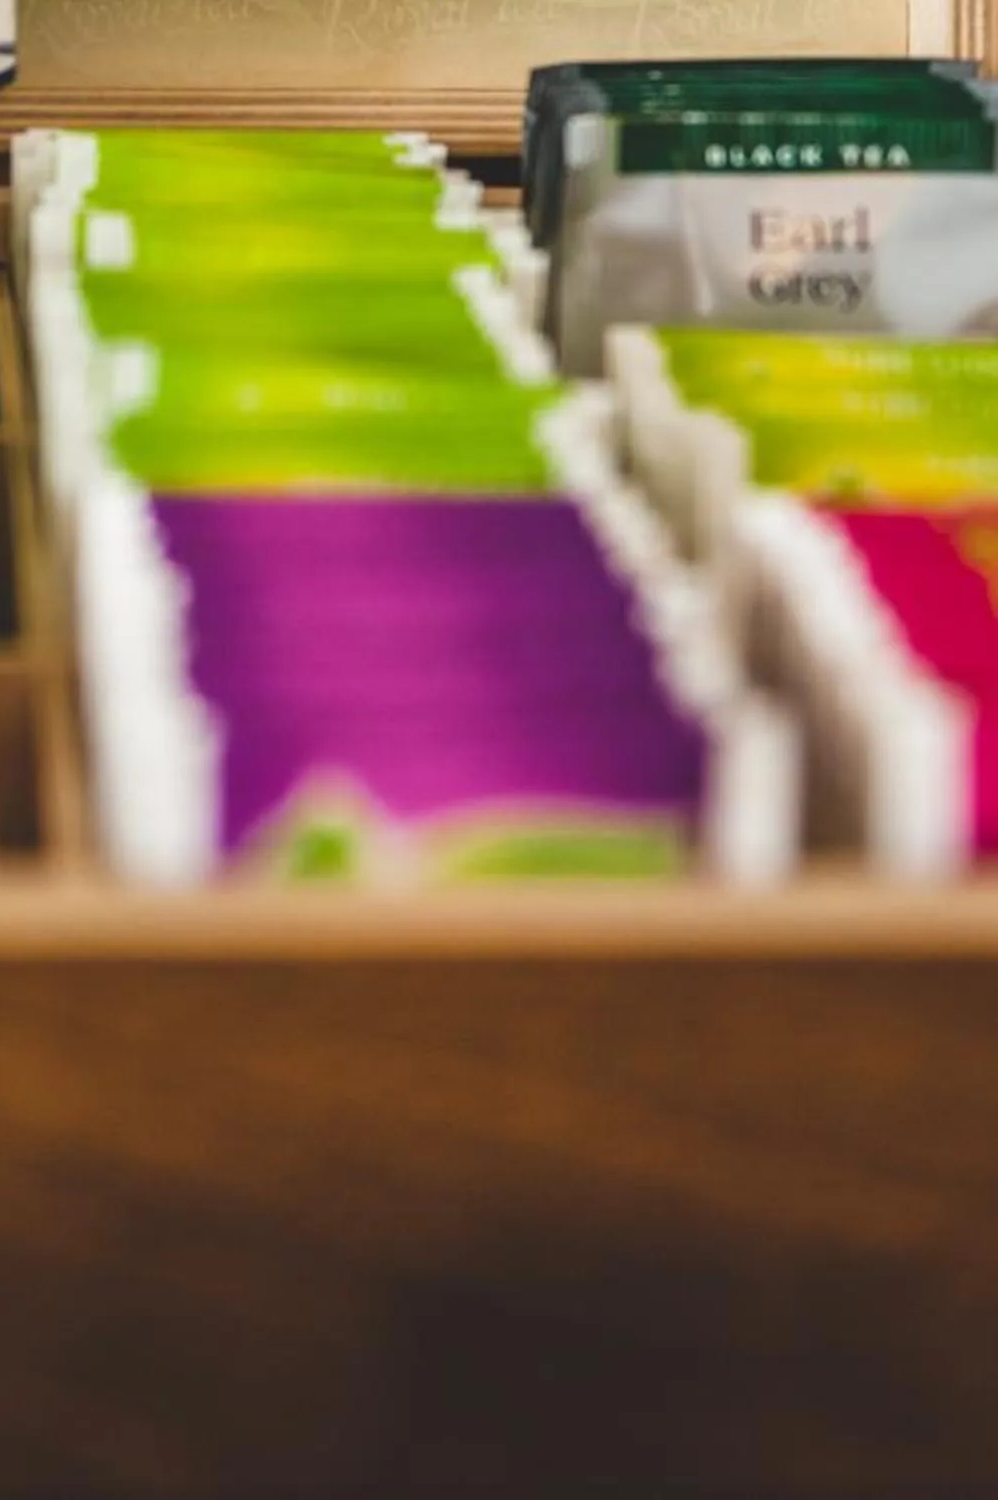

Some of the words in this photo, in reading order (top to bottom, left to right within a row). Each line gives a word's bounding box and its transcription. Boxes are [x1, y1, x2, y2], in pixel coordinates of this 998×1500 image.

[704, 143, 824, 168] BLACK
[839, 143, 911, 168] TEA
[748, 206, 872, 254] Earl
[746, 270, 872, 314] Grey
